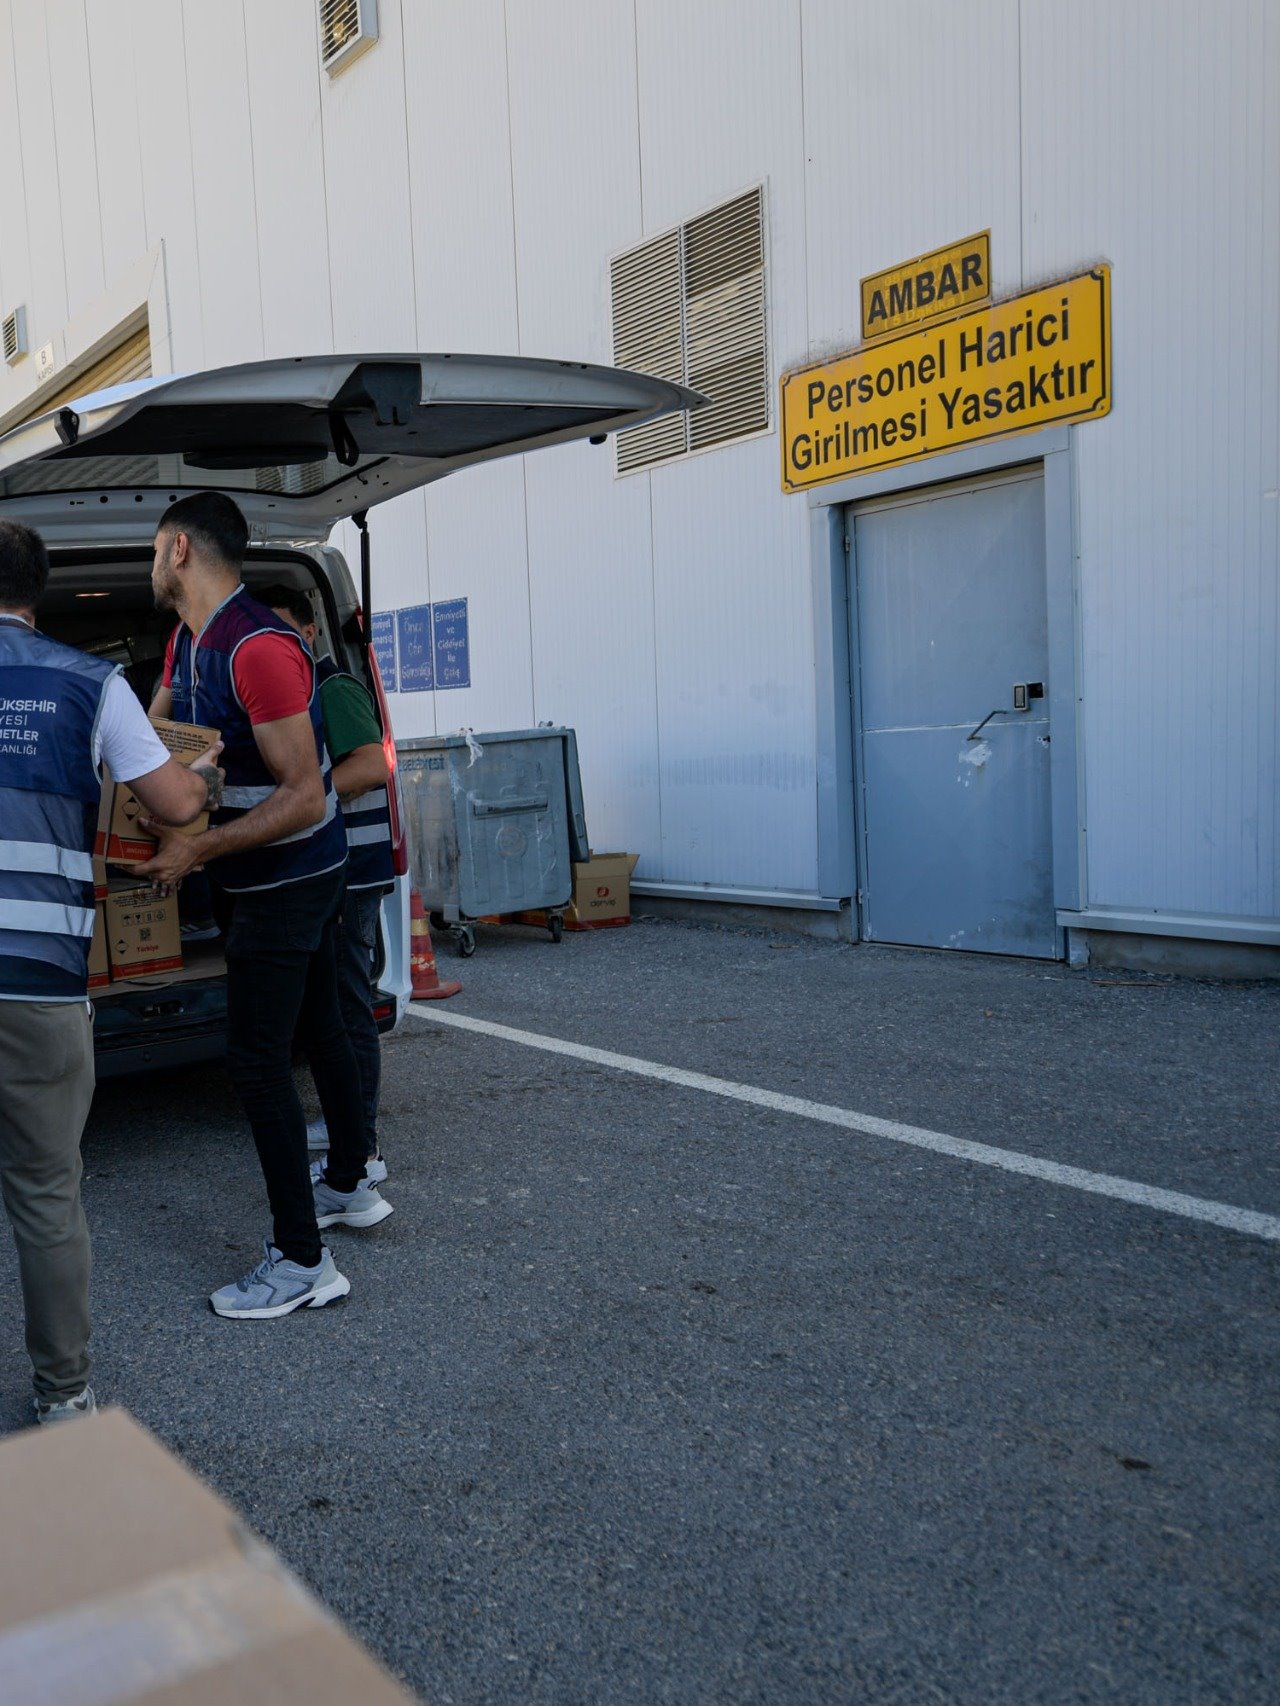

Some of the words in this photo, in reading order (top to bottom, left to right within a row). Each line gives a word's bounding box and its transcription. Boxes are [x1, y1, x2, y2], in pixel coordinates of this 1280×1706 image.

[867, 253, 983, 325] AMBAR
[808, 339, 945, 420] Personel
[960, 297, 1069, 372] Harici
[791, 399, 926, 472] Girilmesi
[938, 359, 1096, 430] Yasaktır
